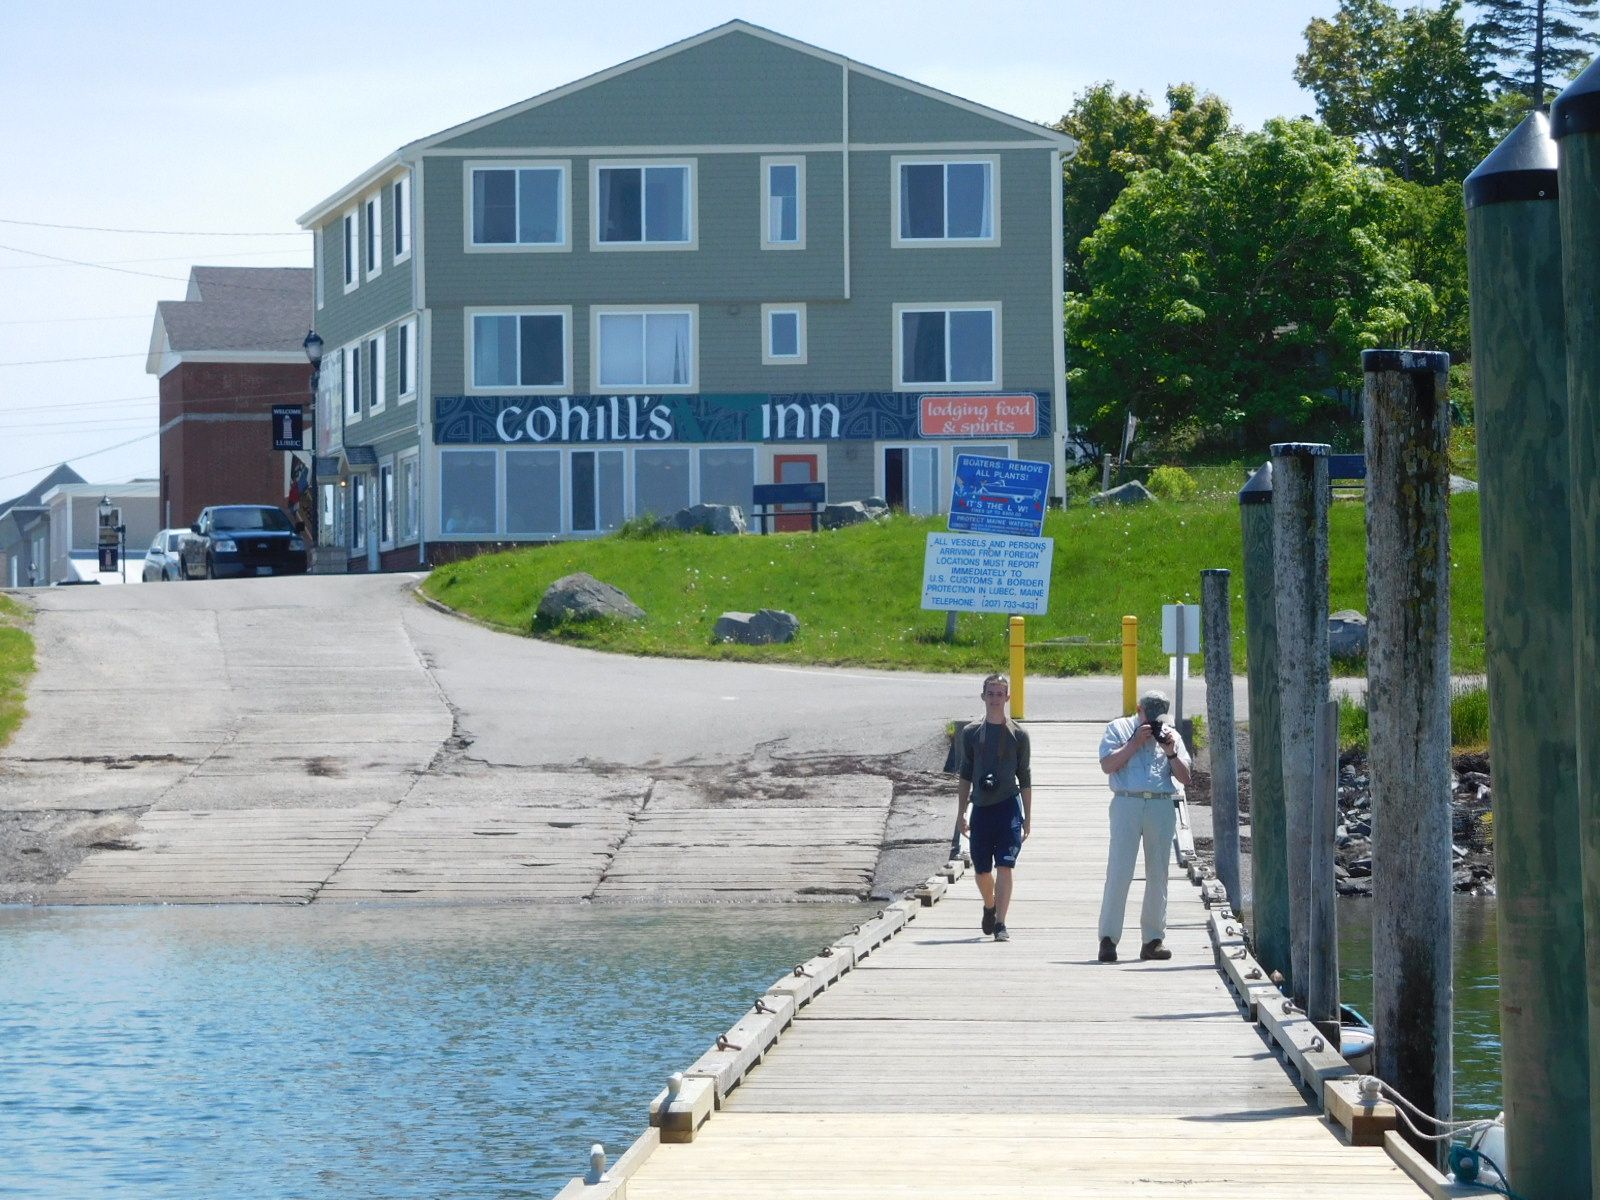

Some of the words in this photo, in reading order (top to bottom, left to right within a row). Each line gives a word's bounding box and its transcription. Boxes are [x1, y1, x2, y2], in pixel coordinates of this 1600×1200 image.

[928, 402, 988, 420] lodging
[995, 401, 1030, 416] food
[762, 402, 840, 439] inn
[943, 421, 955, 433] &
[960, 418, 1015, 437] spirits
[1009, 463, 1043, 473] REMOVE
[976, 469, 989, 477] ALL
[994, 471, 1029, 480] PLANTS!
[987, 502, 1003, 511] THE
[957, 515, 984, 523] PROTECT
[934, 538, 948, 546] ALL
[951, 539, 986, 547] VESSELS
[989, 540, 1006, 548] AND
[1009, 541, 1046, 550] PERSONS
[940, 548, 975, 556] ARRIVING
[979, 549, 1000, 558] FROM
[1004, 550, 1039, 559] FOREIGN
[936, 557, 980, 566] LOCATIONS
[983, 559, 1004, 567] MUST
[1008, 560, 1039, 569] REPORT
[951, 567, 1007, 577] IMMEDIATELY
[1011, 569, 1022, 578] TO
[950, 575, 993, 585] CUSTOMS
[1007, 579, 1044, 588] BORDER
[927, 585, 975, 594] PROTECTION
[978, 586, 986, 594] IN
[989, 586, 1017, 596] LUBEC,
[1020, 588, 1044, 597] MAINE
[981, 599, 1000, 608] (207)
[1003, 600, 1038, 610] 733-4331
